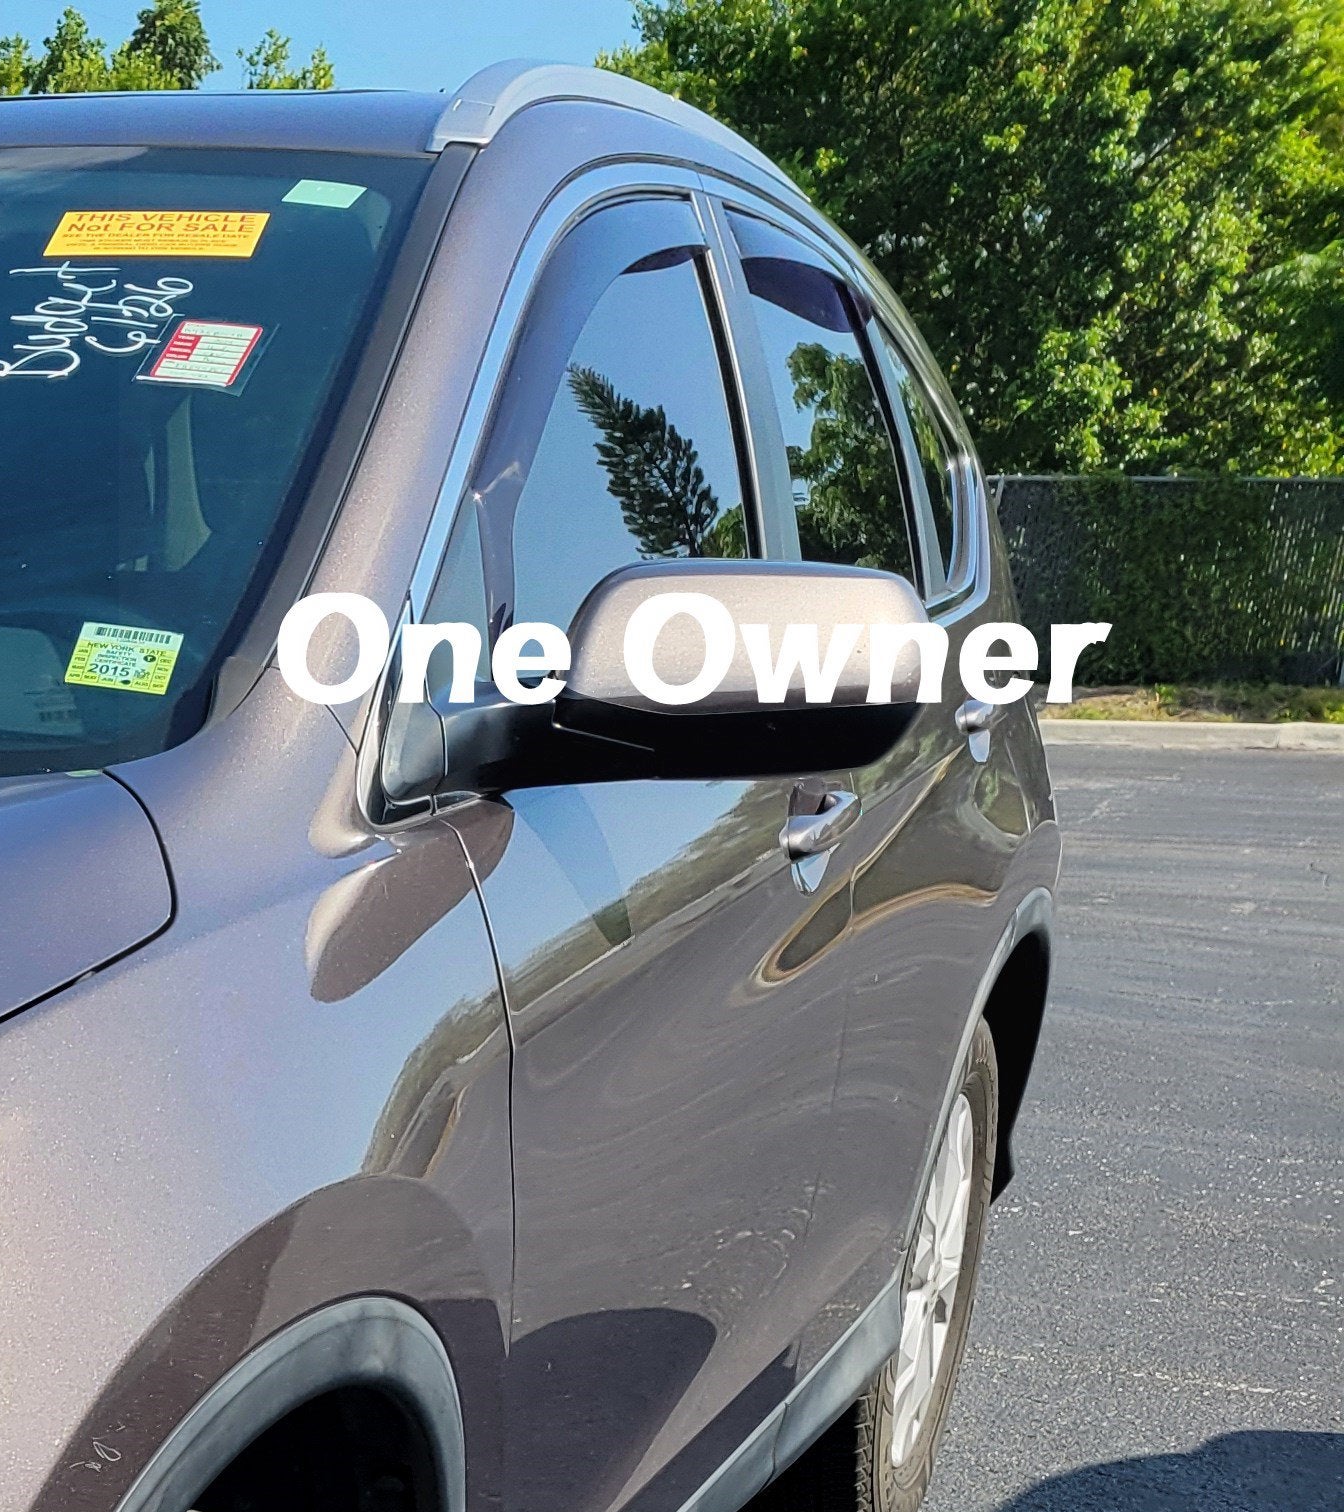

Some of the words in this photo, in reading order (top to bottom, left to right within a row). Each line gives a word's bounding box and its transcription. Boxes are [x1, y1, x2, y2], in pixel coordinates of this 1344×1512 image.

[75, 213, 131, 222] THIS
[142, 213, 256, 222] VEHICLE
[68, 223, 110, 232] Not
[119, 222, 174, 232] FOR
[183, 223, 255, 232] SALE
[87, 641, 109, 649] NEW
[111, 643, 134, 651] YORK
[139, 648, 167, 657] STATE
[87, 663, 130, 677] 2015
